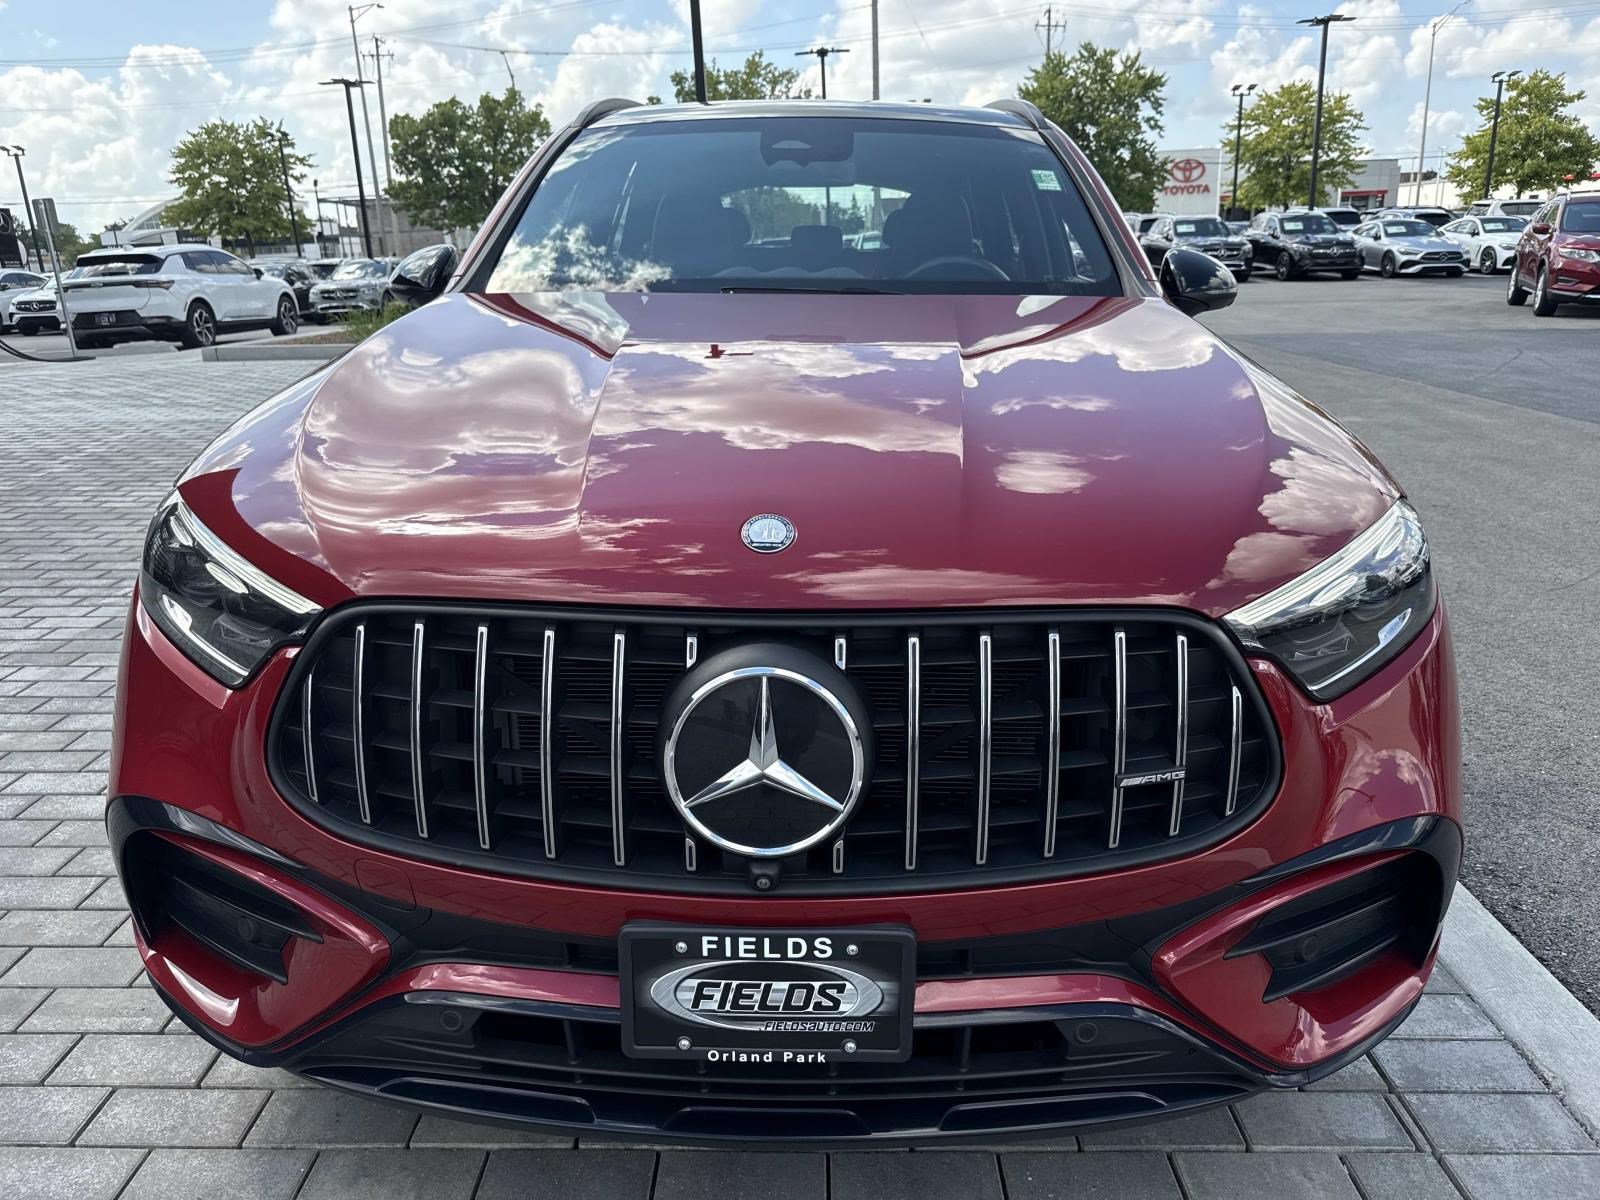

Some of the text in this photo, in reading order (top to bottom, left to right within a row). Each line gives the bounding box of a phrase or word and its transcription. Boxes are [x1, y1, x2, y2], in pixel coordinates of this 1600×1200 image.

[1163, 184, 1210, 195] TOYOTA
[1137, 770, 1186, 784] AMG
[701, 936, 833, 958] FIELDS
[690, 981, 847, 1012] FIELDS
[707, 1050, 826, 1063] Orland Park
